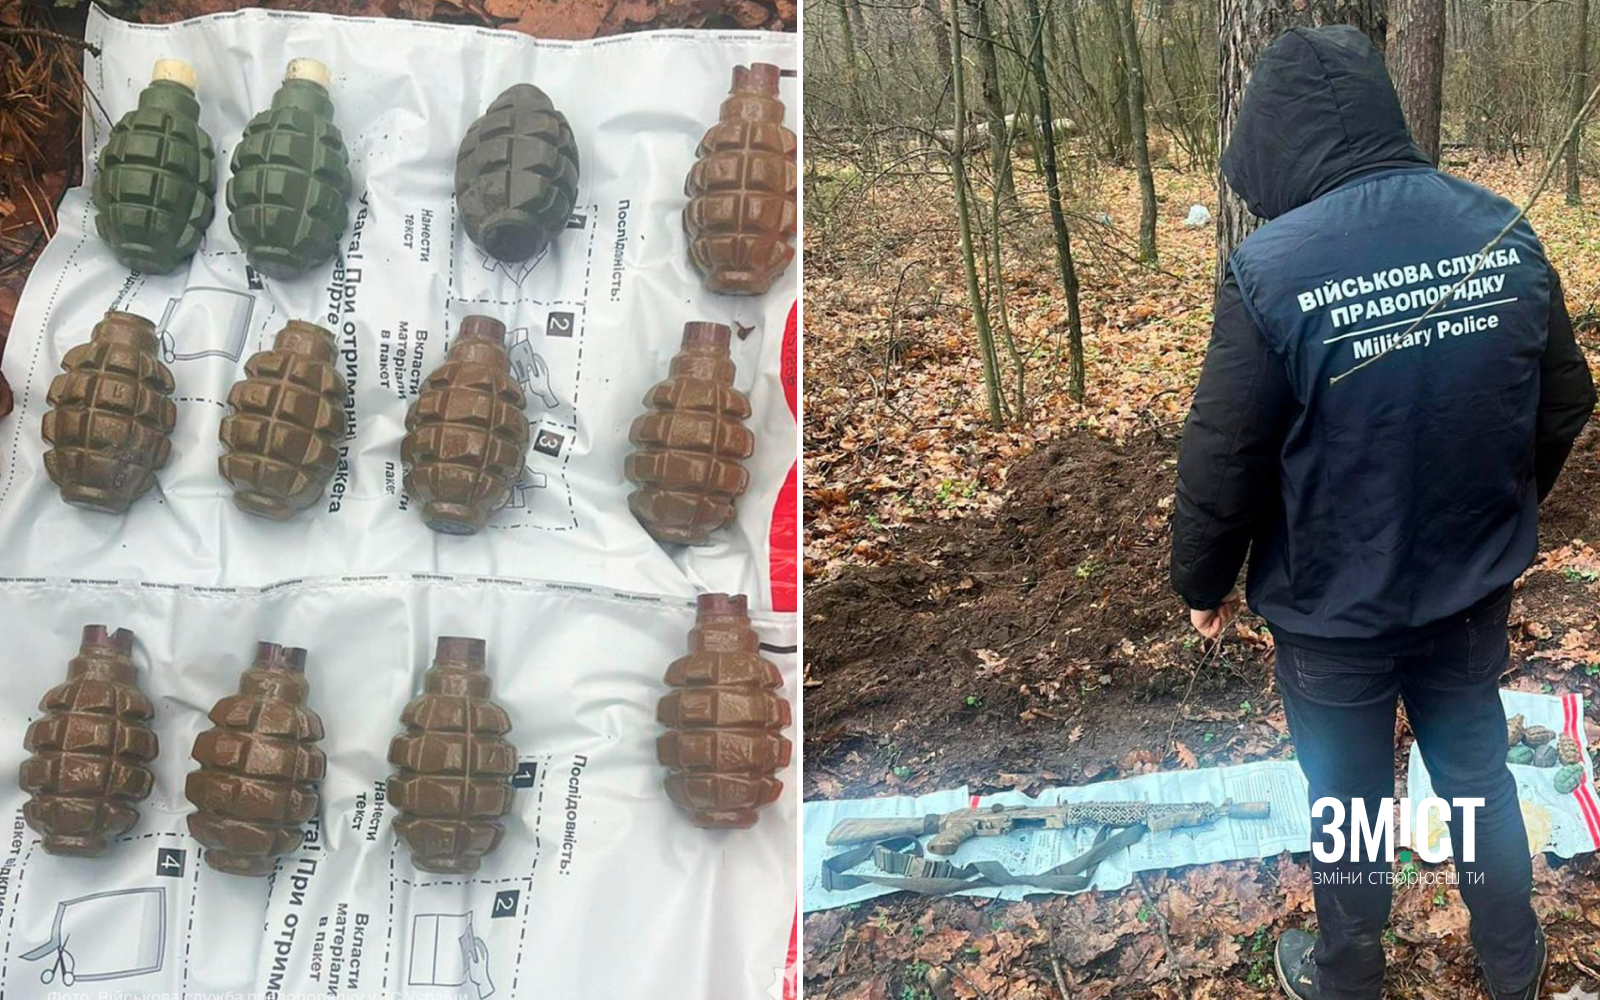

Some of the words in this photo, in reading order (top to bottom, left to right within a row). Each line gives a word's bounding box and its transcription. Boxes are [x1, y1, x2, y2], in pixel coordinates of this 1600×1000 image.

[347, 191, 368, 260] Увага!
[404, 214, 415, 249] текст
[420, 208, 433, 262] Нанести
[344, 268, 362, 313] При
[1297, 262, 1434, 313] ВІЙСЬКОВА
[1436, 247, 1522, 279] СЛУЖБА
[1330, 273, 1506, 328] ПРАВОПОРЯДКУ
[381, 329, 391, 339] в
[550, 317, 570, 331] 2
[1352, 325, 1432, 360] Military
[1437, 313, 1499, 340] Police
[341, 321, 359, 441] отриманні
[380, 343, 390, 388] пакет
[393, 321, 409, 399] матеріали
[410, 330, 428, 395] Вкласти
[539, 435, 558, 449] 3
[329, 447, 349, 513] пакета
[514, 770, 532, 780] 1
[352, 792, 367, 831] текст
[367, 781, 386, 841] Нанести
[559, 754, 588, 876] Послідовність:
[160, 854, 181, 869] 4
[289, 857, 318, 906] При
[319, 916, 328, 927] в
[496, 897, 513, 911] 2
[310, 931, 328, 982] пакет
[327, 903, 348, 998] матеріали
[347, 912, 369, 990] Вкласти
